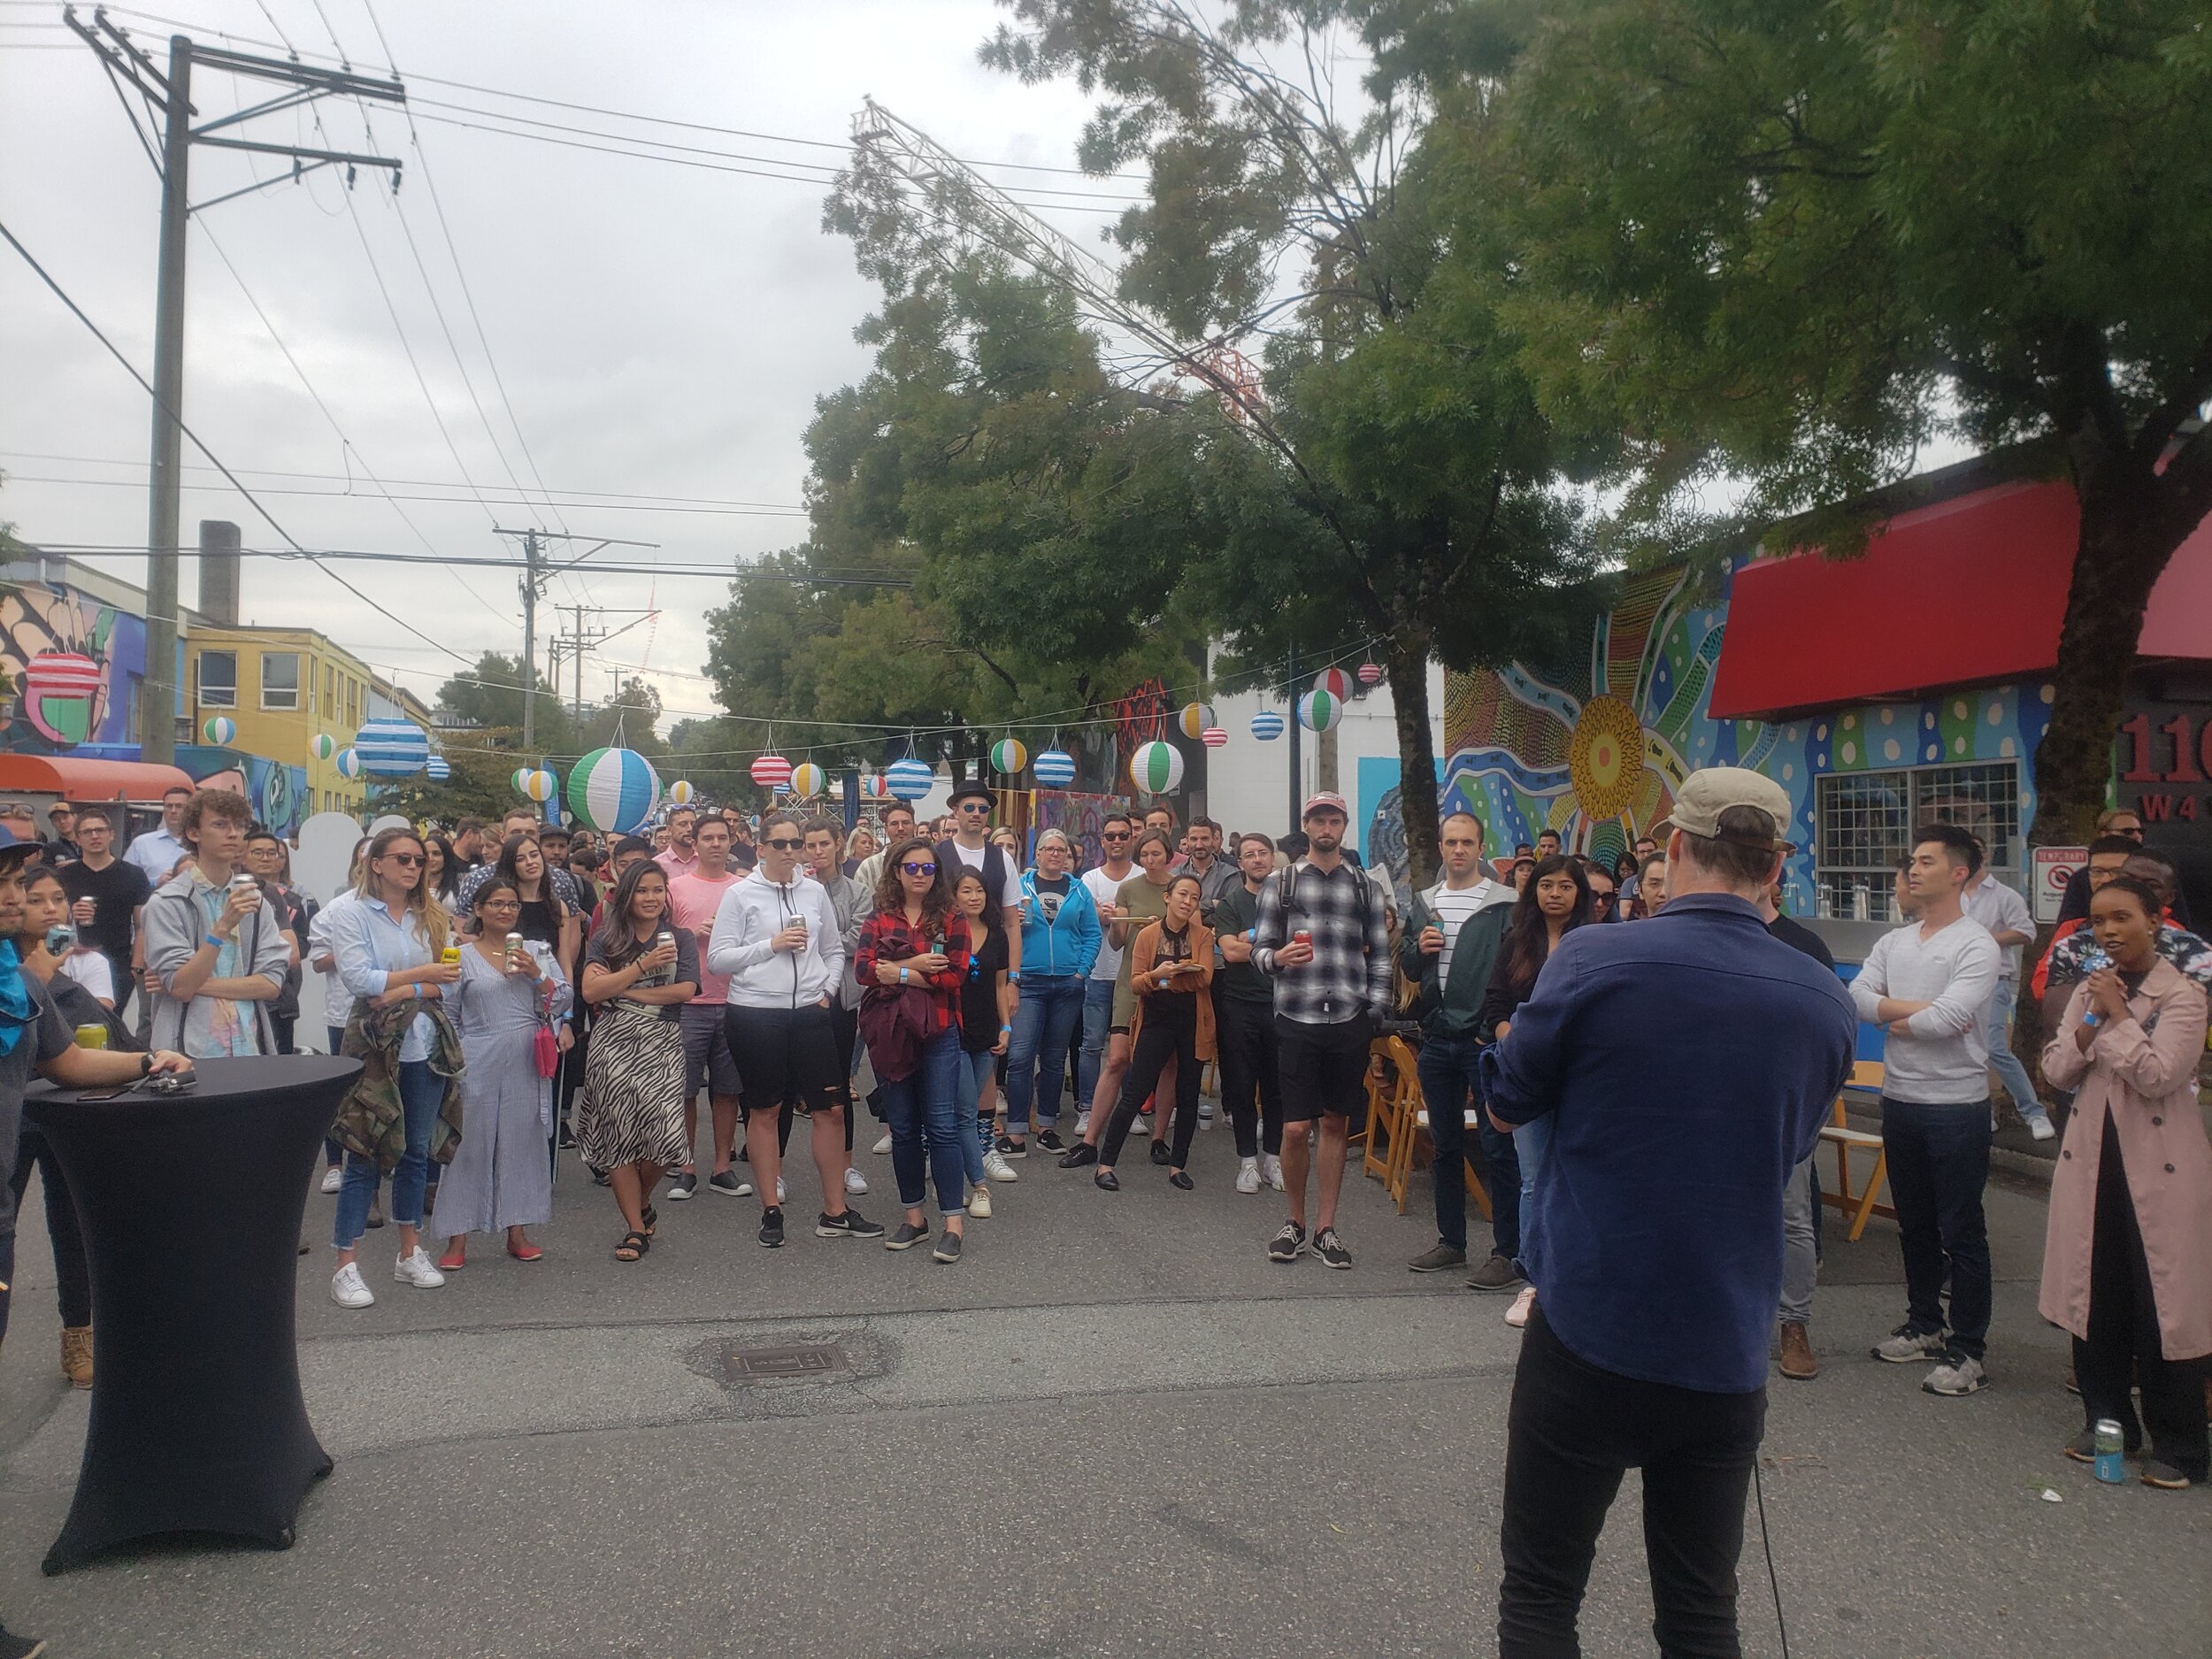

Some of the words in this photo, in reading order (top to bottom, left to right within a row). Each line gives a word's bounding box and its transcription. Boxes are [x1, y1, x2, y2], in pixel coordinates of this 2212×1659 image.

[2123, 712, 2212, 782] 11
[2141, 794, 2172, 821] W
[2038, 851, 2086, 862] TEMPORARY
